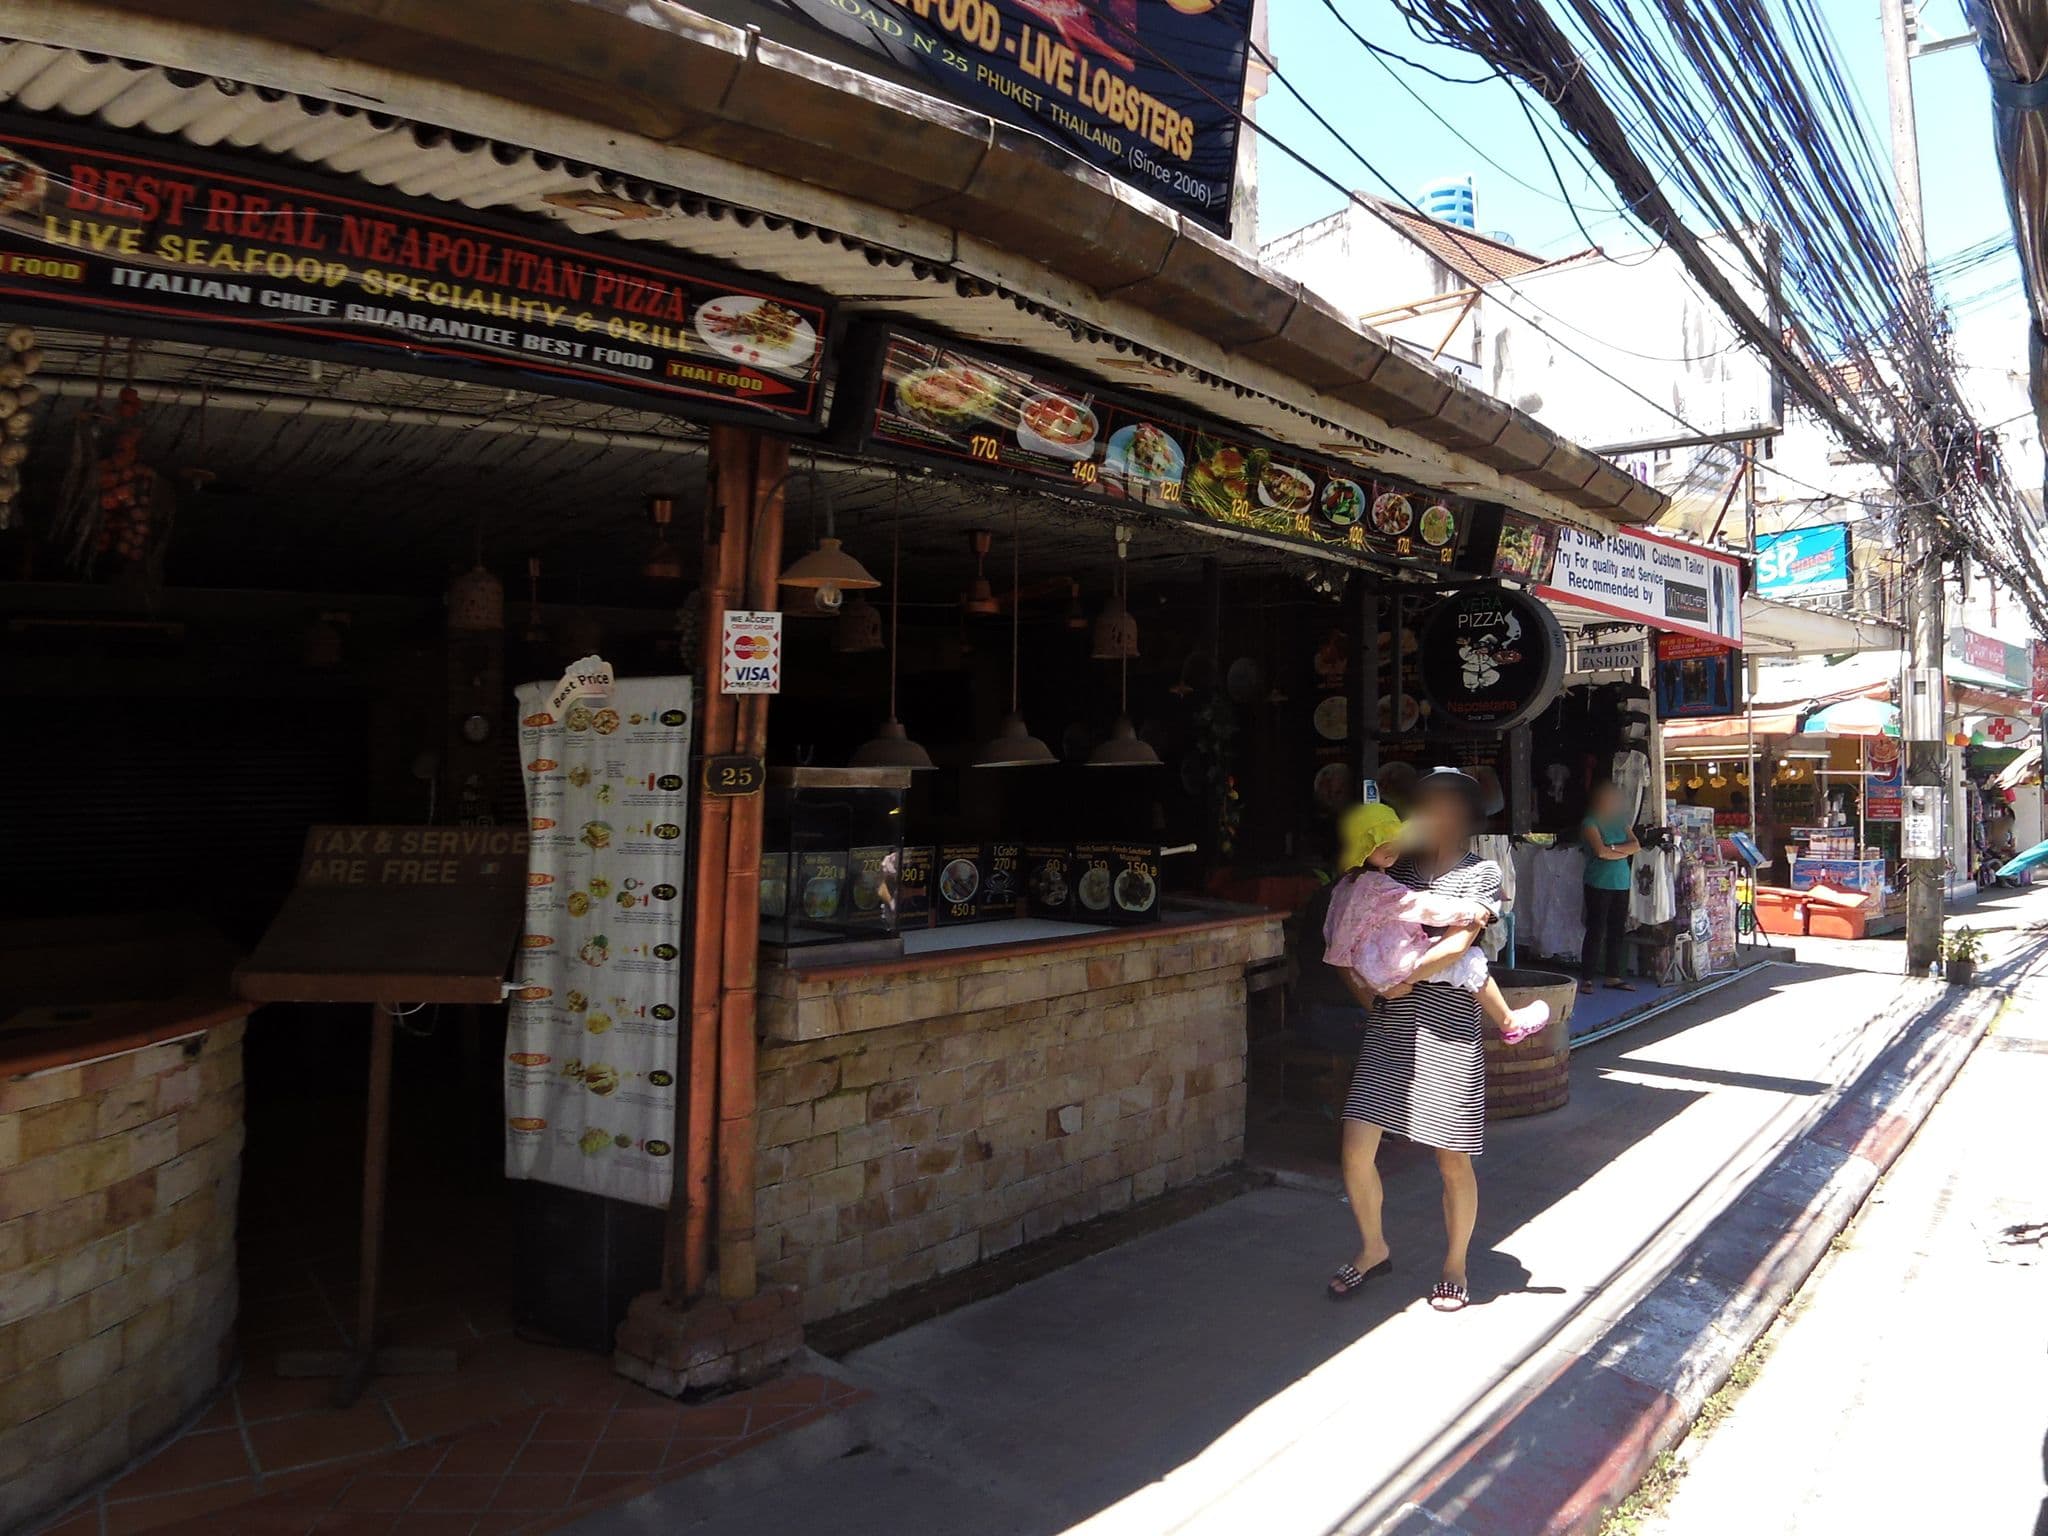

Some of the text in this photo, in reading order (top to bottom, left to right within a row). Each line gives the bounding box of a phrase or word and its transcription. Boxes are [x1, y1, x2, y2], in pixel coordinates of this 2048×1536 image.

[830, 0, 904, 37] OAD
[942, 49, 969, 72] 25
[977, 65, 1043, 112] PHUKET
[1051, 103, 1125, 158] THAILAND.
[1129, 146, 1171, 184] (Since
[1174, 171, 1212, 208] 2006)
[1019, 24, 1075, 96] LIVE
[1078, 57, 1194, 161] LOBSTERS
[66, 164, 685, 323] BEST REAL NEAPOLITAN PIZZA
[11, 254, 81, 280] FOOD
[45, 215, 145, 256] LIVE
[156, 233, 349, 289] SEAFOOD
[359, 268, 568, 327] SPECIALITY
[607, 316, 694, 352] GRILL
[112, 267, 654, 370] ITALIAN CHEF GUARANTEE BEST FOOD
[671, 363, 763, 391] THAI FOOD
[1558, 548, 1664, 585] Try For quality and Service
[1606, 535, 1646, 562] FASHION
[1651, 548, 1682, 571] Custom
[1684, 556, 1704, 575] Tailor
[1568, 571, 1639, 599] Recommended
[1643, 587, 1654, 604] by
[730, 615, 775, 624] WE ACCEPT
[1457, 611, 1505, 629] PIZZA
[1583, 654, 1639, 668] FASHION
[1614, 644, 1638, 653] STAR
[735, 667, 770, 681] VISA
[553, 672, 610, 709] Best Price
[721, 768, 752, 786] 25
[313, 831, 369, 854] TAX
[373, 831, 394, 854] &
[399, 831, 530, 855] SERVICE
[308, 859, 458, 884] ARE FREE
[1127, 861, 1149, 874] 150
[951, 903, 969, 916] 450
